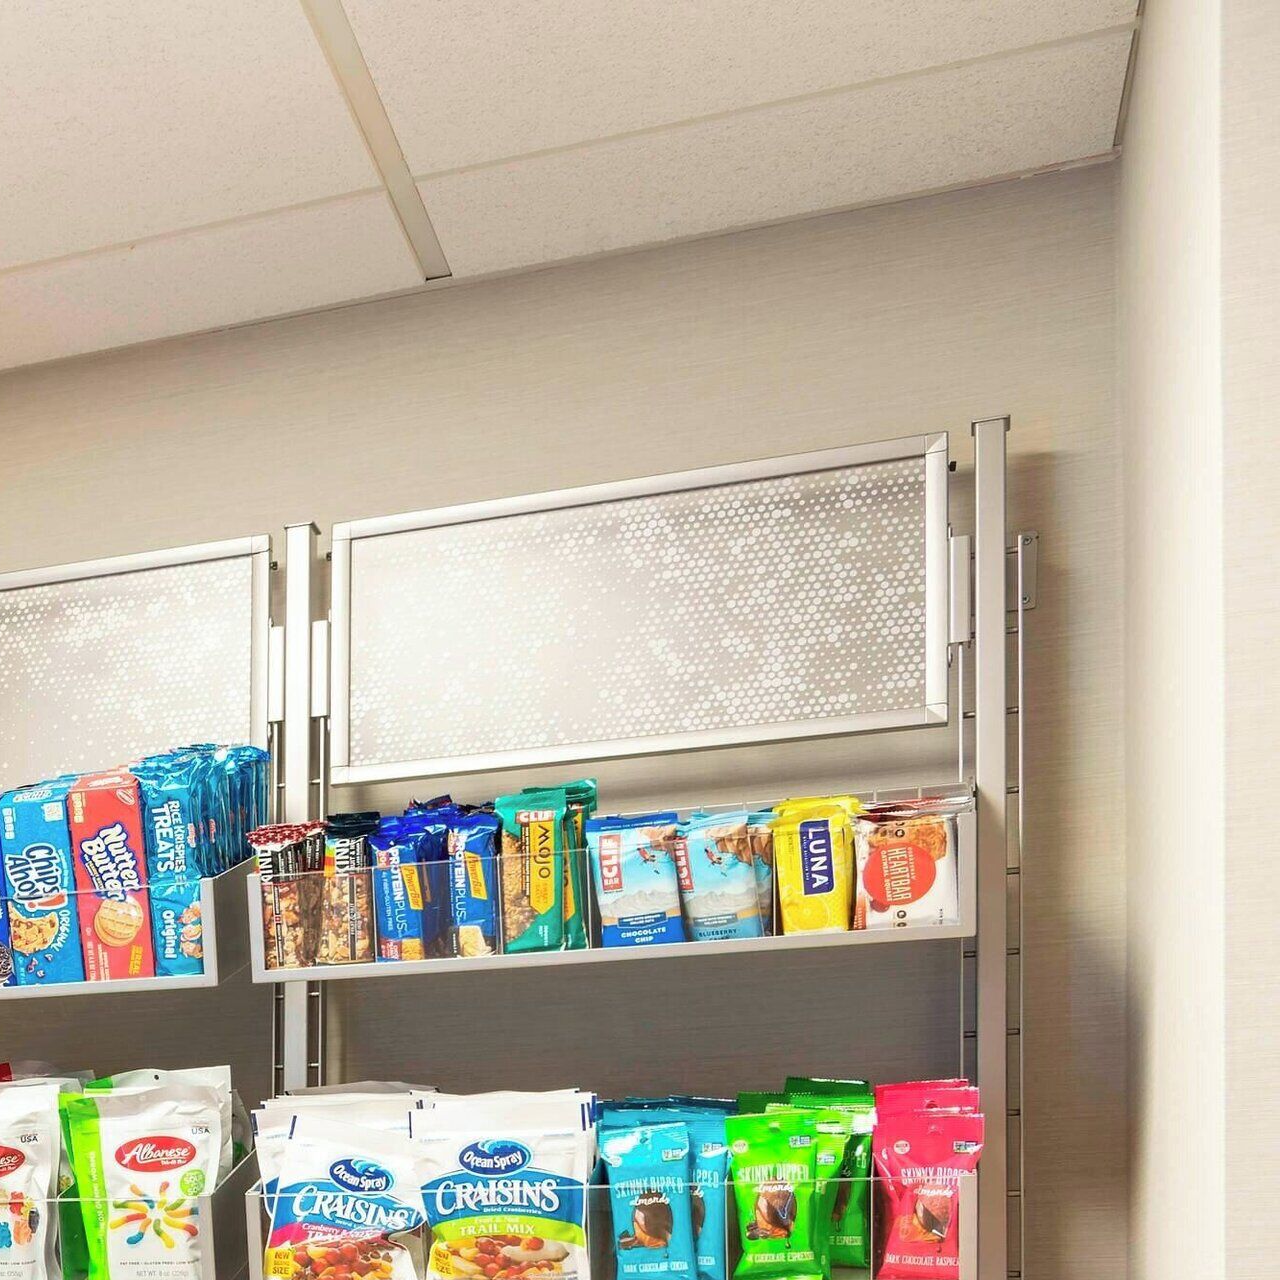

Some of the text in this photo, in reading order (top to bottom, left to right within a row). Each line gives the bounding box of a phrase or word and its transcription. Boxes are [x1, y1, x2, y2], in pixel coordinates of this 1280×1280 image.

[152, 805, 176, 873] TREATS
[80, 837, 126, 902] Butter
[99, 824, 140, 892] Nutter
[601, 836, 618, 877] CLIF
[809, 827, 828, 889] LUNA
[162, 910, 178, 959] Original
[621, 927, 667, 939] CHOCOLATE
[698, 928, 737, 938] BLUEBERRY
[124, 1143, 190, 1164] Albanese
[463, 1150, 524, 1171] Ocean Spray
[739, 1163, 810, 1182] SKINNY DIPPED
[435, 1178, 559, 1216] CRAISINS
[615, 1177, 684, 1199] SKINNY DIPPED
[459, 1223, 536, 1236] TRAIL MIX
